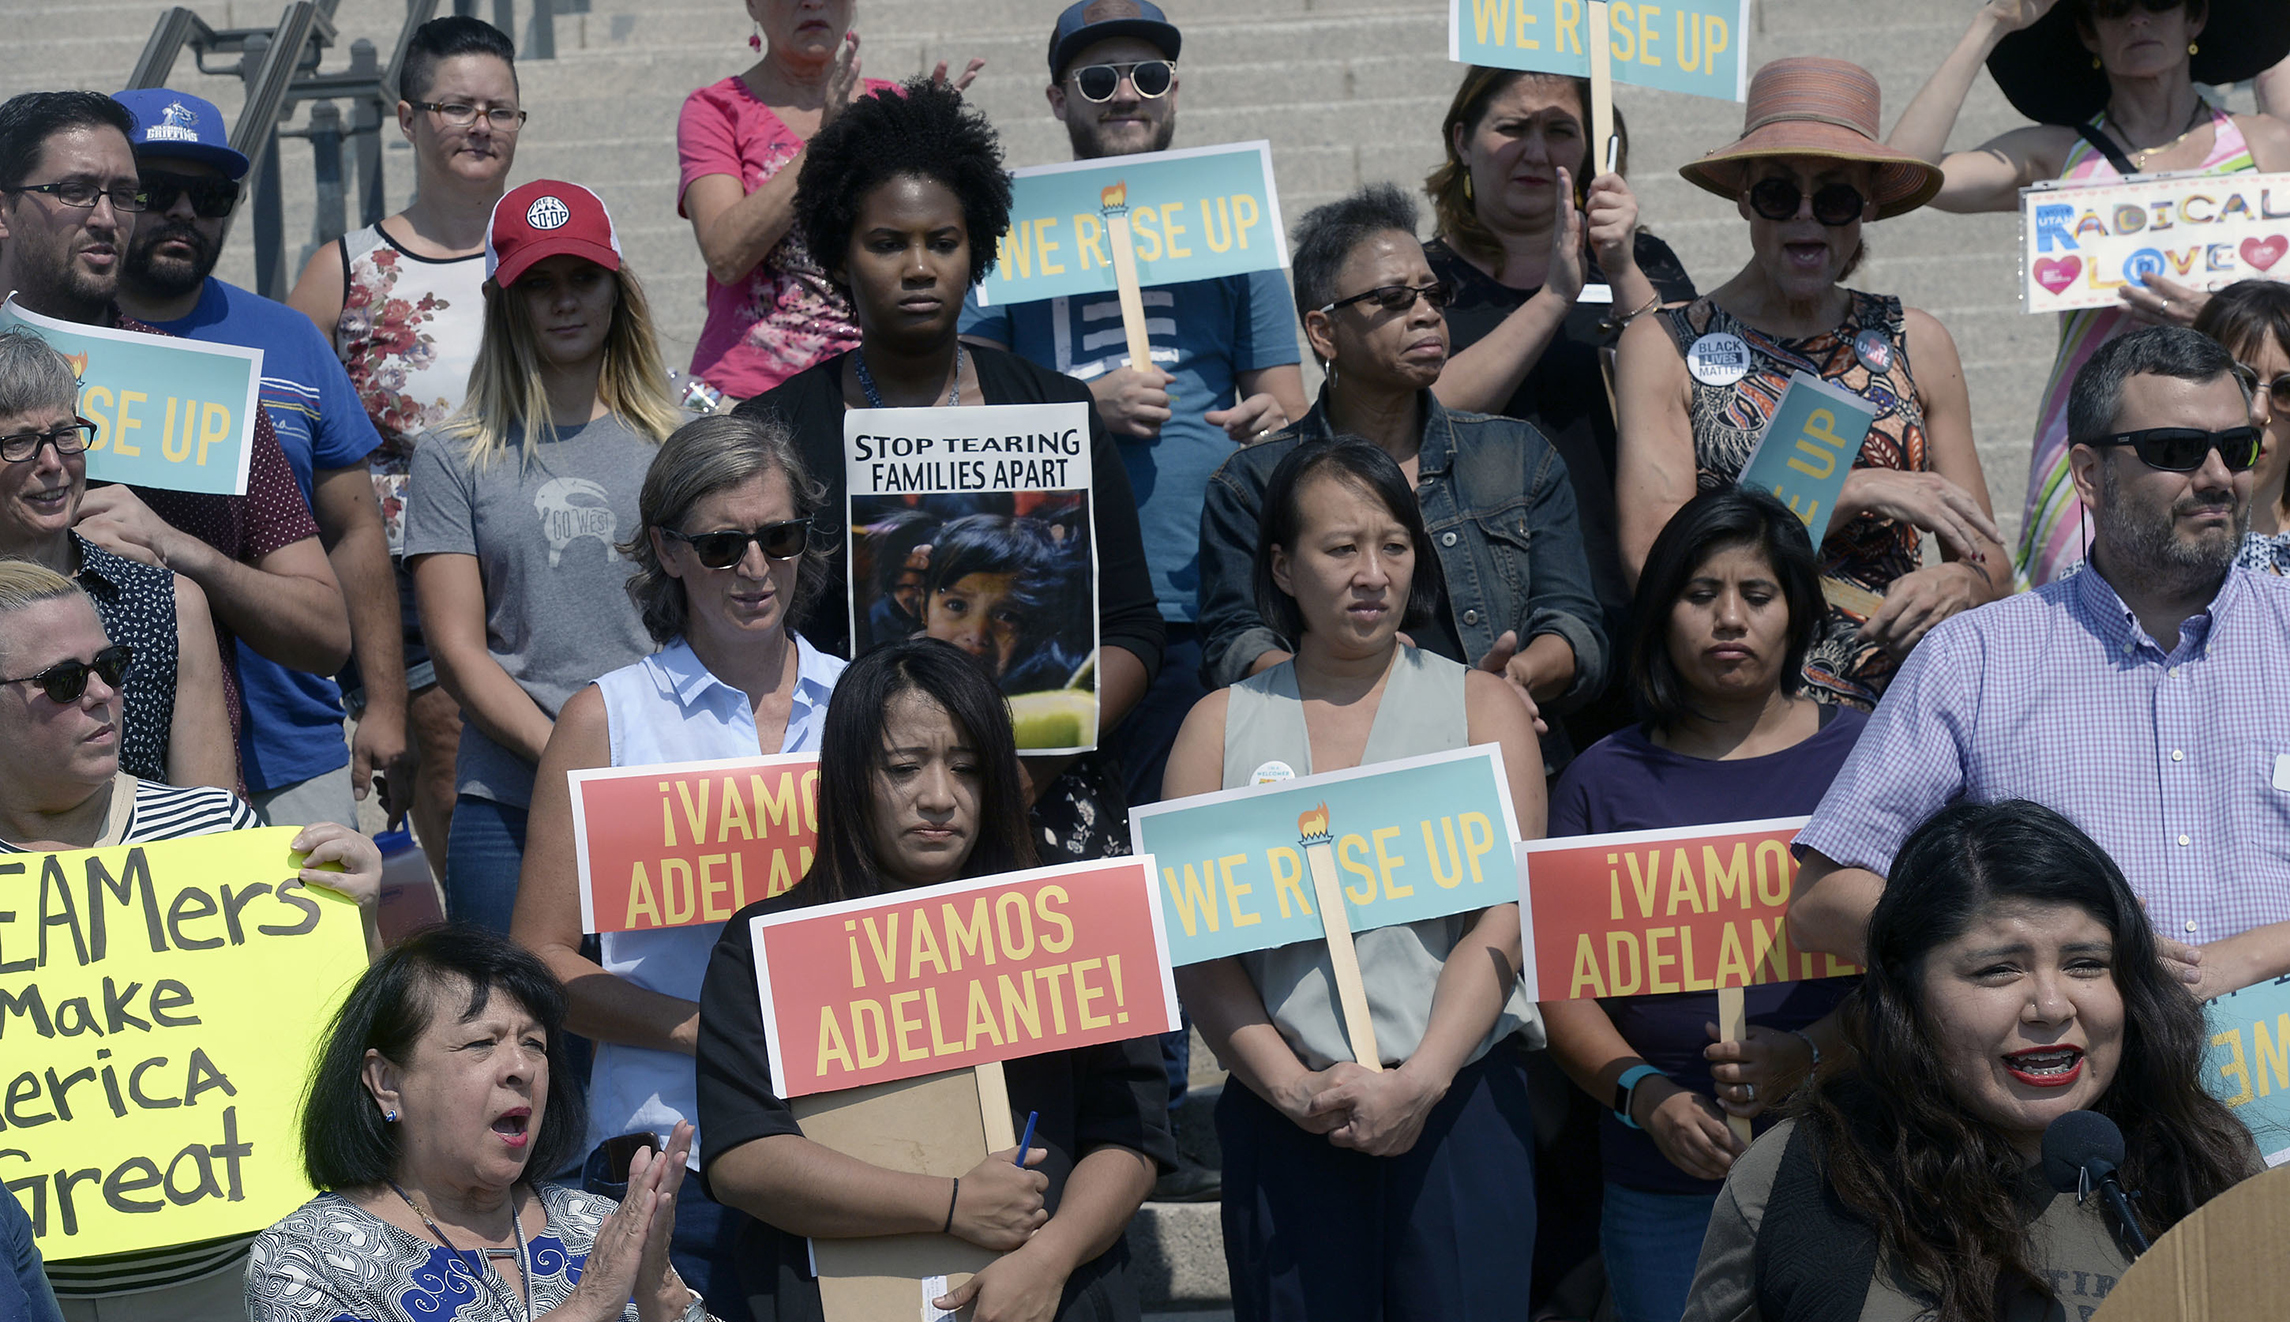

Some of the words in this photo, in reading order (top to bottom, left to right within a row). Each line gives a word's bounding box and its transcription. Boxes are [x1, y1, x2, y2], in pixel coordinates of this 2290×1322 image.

[1473, 0, 1540, 50] WE
[1554, 0, 1661, 67] RSE
[1676, 10, 1729, 75] UP
[996, 217, 1066, 281] WE
[1073, 202, 1192, 270] RSE
[1201, 194, 1260, 253] UP
[2035, 189, 2290, 253] RADICAL
[2087, 245, 2235, 290] LOVE
[1699, 340, 1742, 353] BLACK
[1699, 364, 1745, 377] MATTER
[1704, 352, 1738, 364] LIVES
[162, 396, 231, 466] UP
[855, 434, 934, 462] STOP
[942, 429, 1080, 456] TEARING
[1786, 408, 1847, 480] UP
[872, 460, 987, 492] FAMILIES
[993, 458, 1068, 489] APART
[553, 510, 571, 541] GO
[572, 508, 610, 536] WEST
[658, 769, 821, 848] ¡VAMO
[1162, 853, 1262, 938] WE
[1266, 825, 1415, 920] RSE
[1420, 811, 1495, 890] UP
[1607, 839, 1801, 920] ¡VAMO
[844, 884, 1075, 989] ¡VAMOS
[0, 976, 202, 1039] Make
[816, 954, 1130, 1077] ADELANTE!
